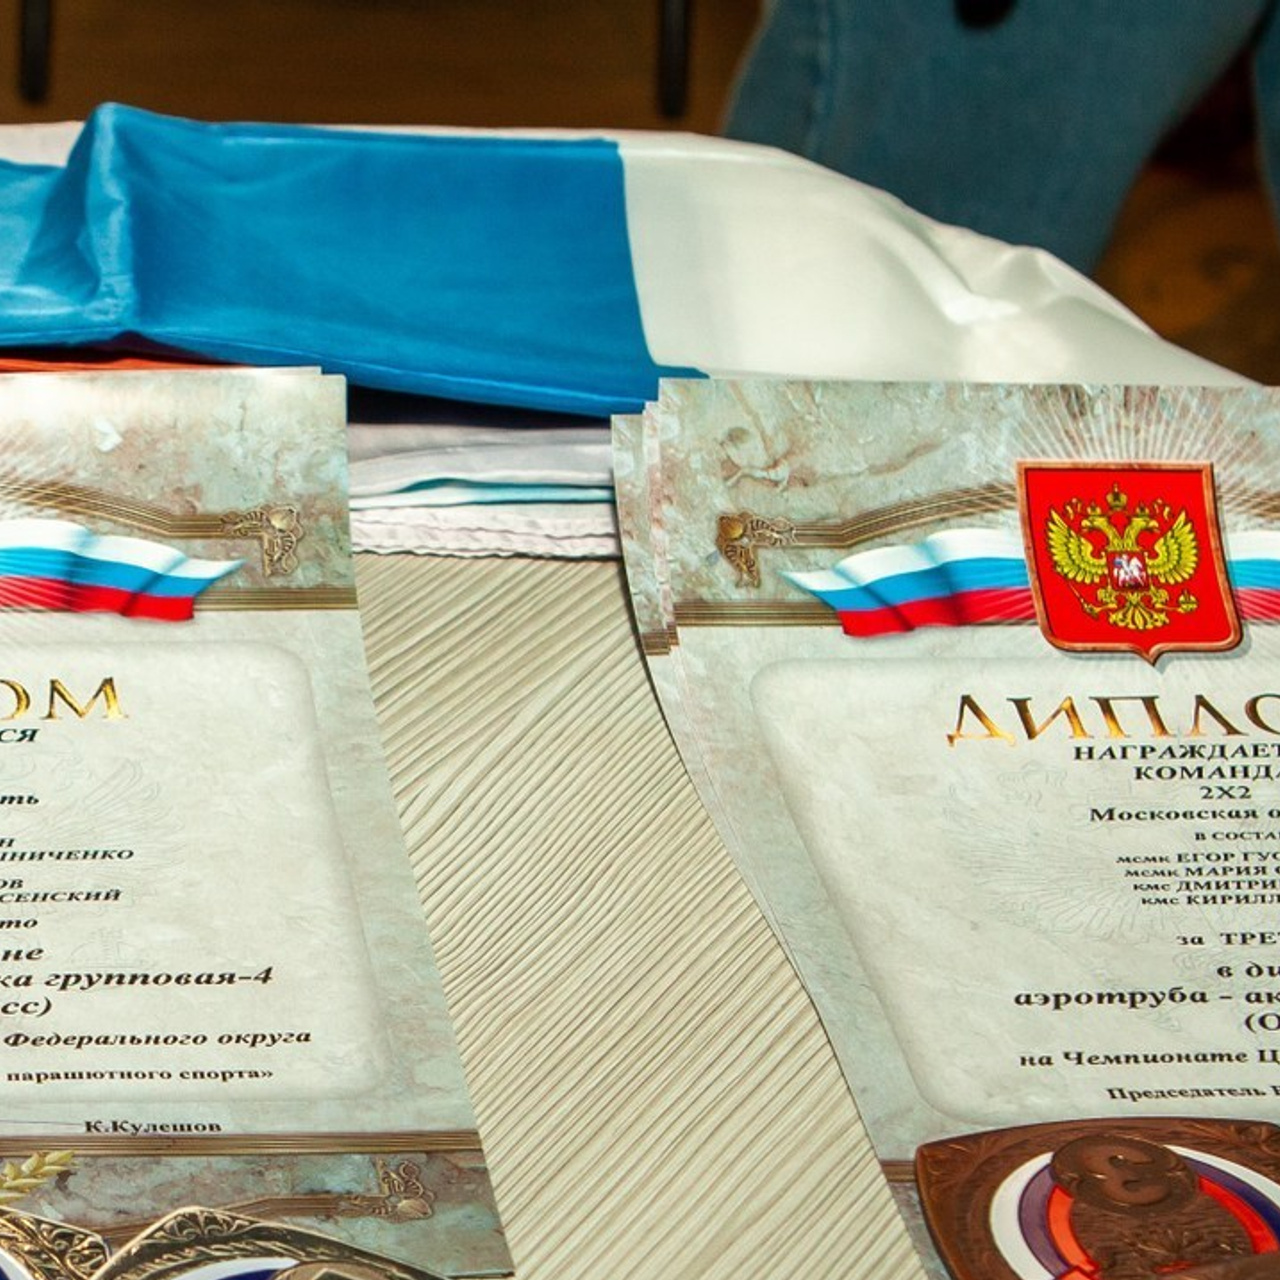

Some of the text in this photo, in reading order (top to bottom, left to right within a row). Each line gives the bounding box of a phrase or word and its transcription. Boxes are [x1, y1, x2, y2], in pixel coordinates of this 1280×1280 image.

[1134, 764, 1280, 781] КОМАНД
[1200, 785, 1252, 799] 2Х2
[1090, 807, 1259, 822] Московская
[1212, 832, 1280, 840] СОСТА
[1116, 856, 1170, 864] мсмк
[1177, 852, 1235, 863] ЕГОР
[1124, 869, 1179, 878] мсмк
[1184, 866, 1267, 877] МАРИЯ
[1133, 879, 1280, 892] кмс ДМИТРИ
[1142, 897, 1179, 905] кмс
[1177, 931, 1280, 946] за ТРЕ
[44, 967, 274, 990] групповая-4
[1217, 966, 1233, 978] в
[1014, 987, 1209, 1010] аэротруба
[3, 1032, 207, 1050] Федерального
[218, 1029, 312, 1047] округа
[1020, 1055, 1053, 1067] на
[1063, 1051, 1249, 1066] Чемпионате
[7, 1068, 172, 1086] парашютного
[179, 1066, 273, 1084] спорта»
[1107, 1086, 1266, 1102] Председатель
[85, 1120, 221, 1136] К.Кулешов
